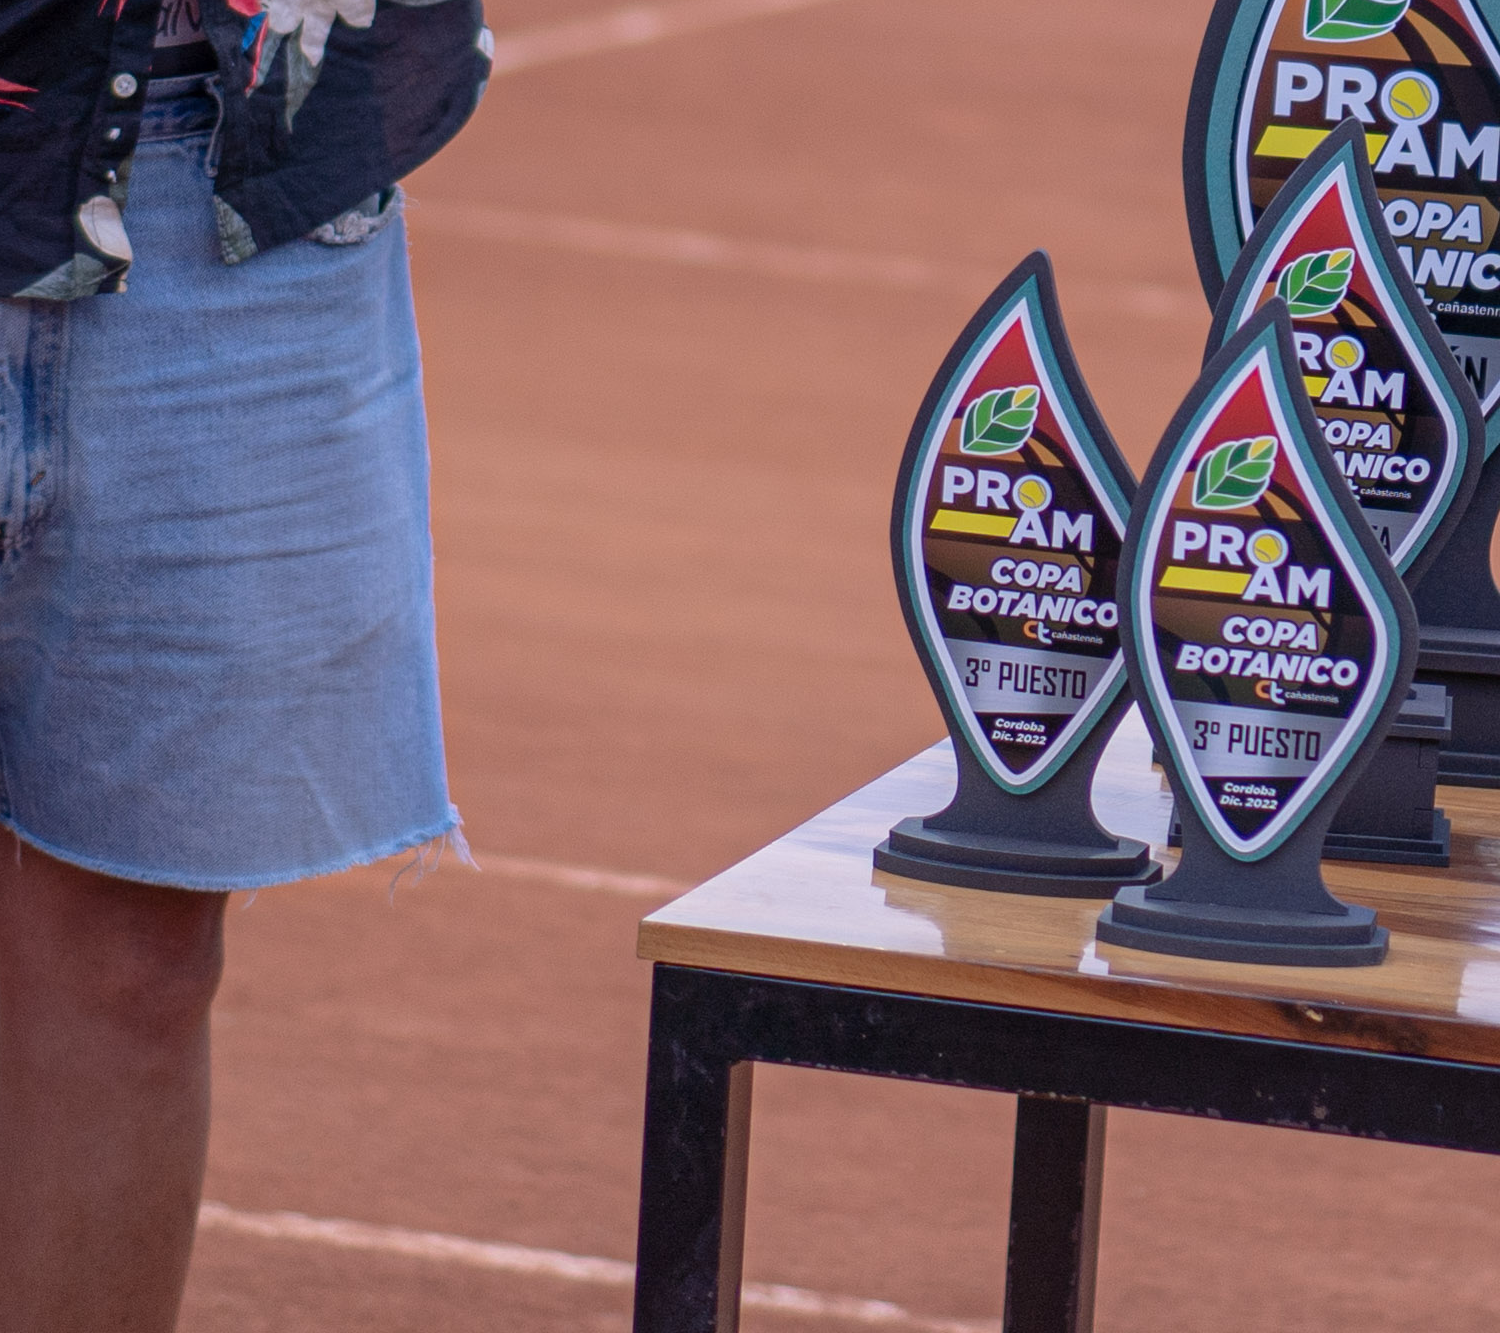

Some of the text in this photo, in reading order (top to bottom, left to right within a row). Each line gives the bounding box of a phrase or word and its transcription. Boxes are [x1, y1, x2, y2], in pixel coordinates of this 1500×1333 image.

[1274, 60, 1440, 126] PRO
[1380, 198, 1483, 244] OPA
[1295, 331, 1364, 373] RO
[1320, 369, 1405, 410] AM
[1316, 418, 1392, 450] OPA
[1332, 450, 1431, 483] NICO
[942, 465, 1052, 512] PRO
[1009, 509, 1093, 552] AM
[1172, 520, 1289, 569] PRO
[991, 558, 1082, 593] COPA
[1242, 565, 1331, 608] AM
[948, 584, 1118, 628] BOTANICO
[1221, 615, 1318, 651] COPA
[999, 661, 1087, 700] PUESTO
[1175, 644, 1359, 687] BOTANICO
[991, 730, 1047, 746] Dic. 2022
[995, 717, 1046, 733] Cordoba
[1228, 723, 1321, 762] PUESTO
[1219, 794, 1278, 810] Dic. 2022
[1222, 782, 1276, 797] Cordoba
